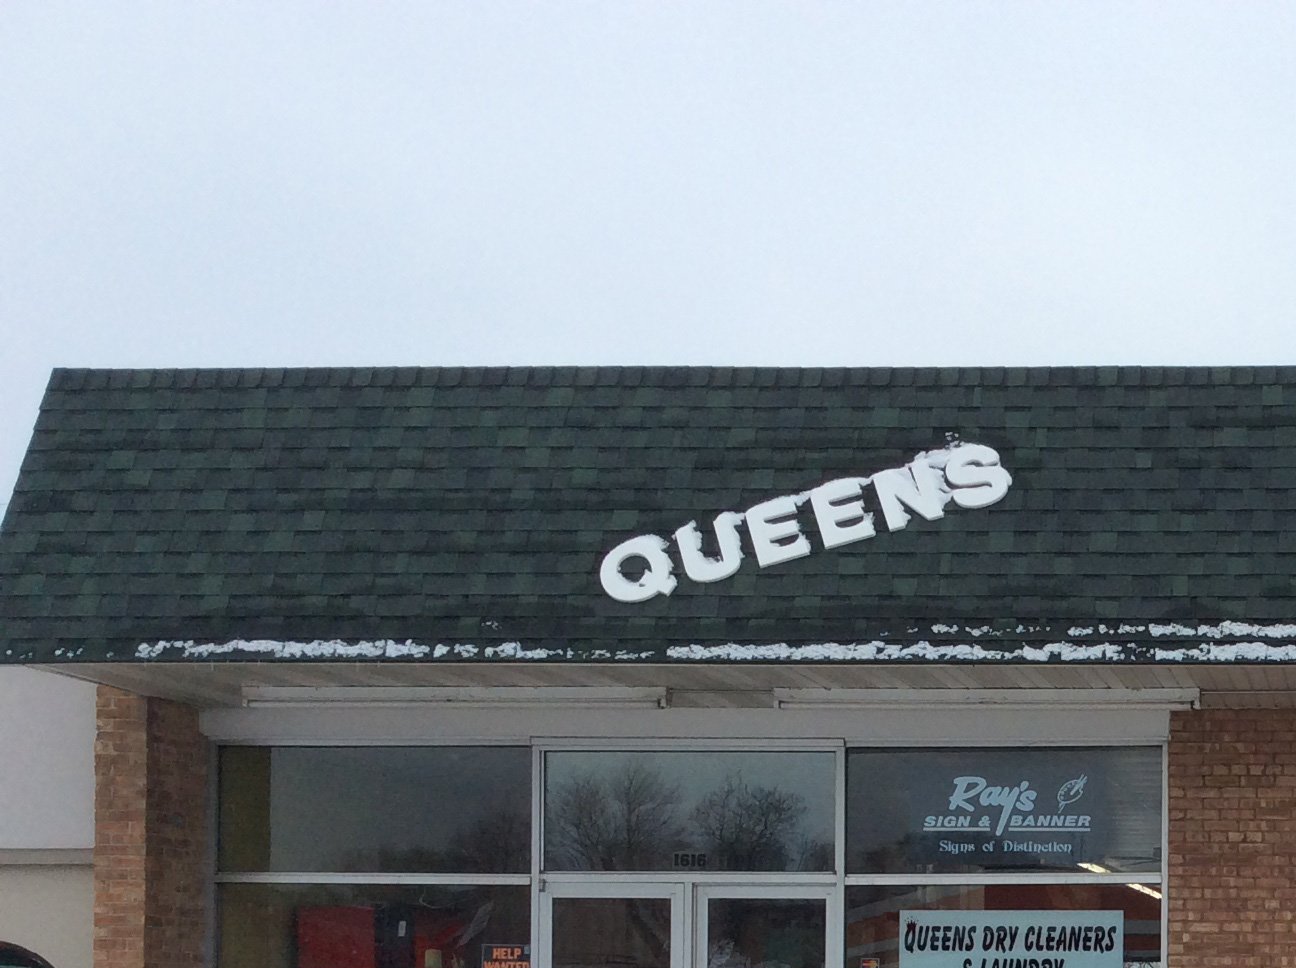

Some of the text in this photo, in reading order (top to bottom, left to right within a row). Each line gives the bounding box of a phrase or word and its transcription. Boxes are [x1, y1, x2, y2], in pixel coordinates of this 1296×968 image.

[948, 776, 1038, 837] Ray's
[923, 815, 1092, 827] SIGN & BANNER
[938, 840, 1073, 855] Signs of Distinction
[673, 853, 707, 867] 1616
[904, 922, 1117, 954] QUEENS DRY CLEANERS
[492, 947, 522, 960] HELP
